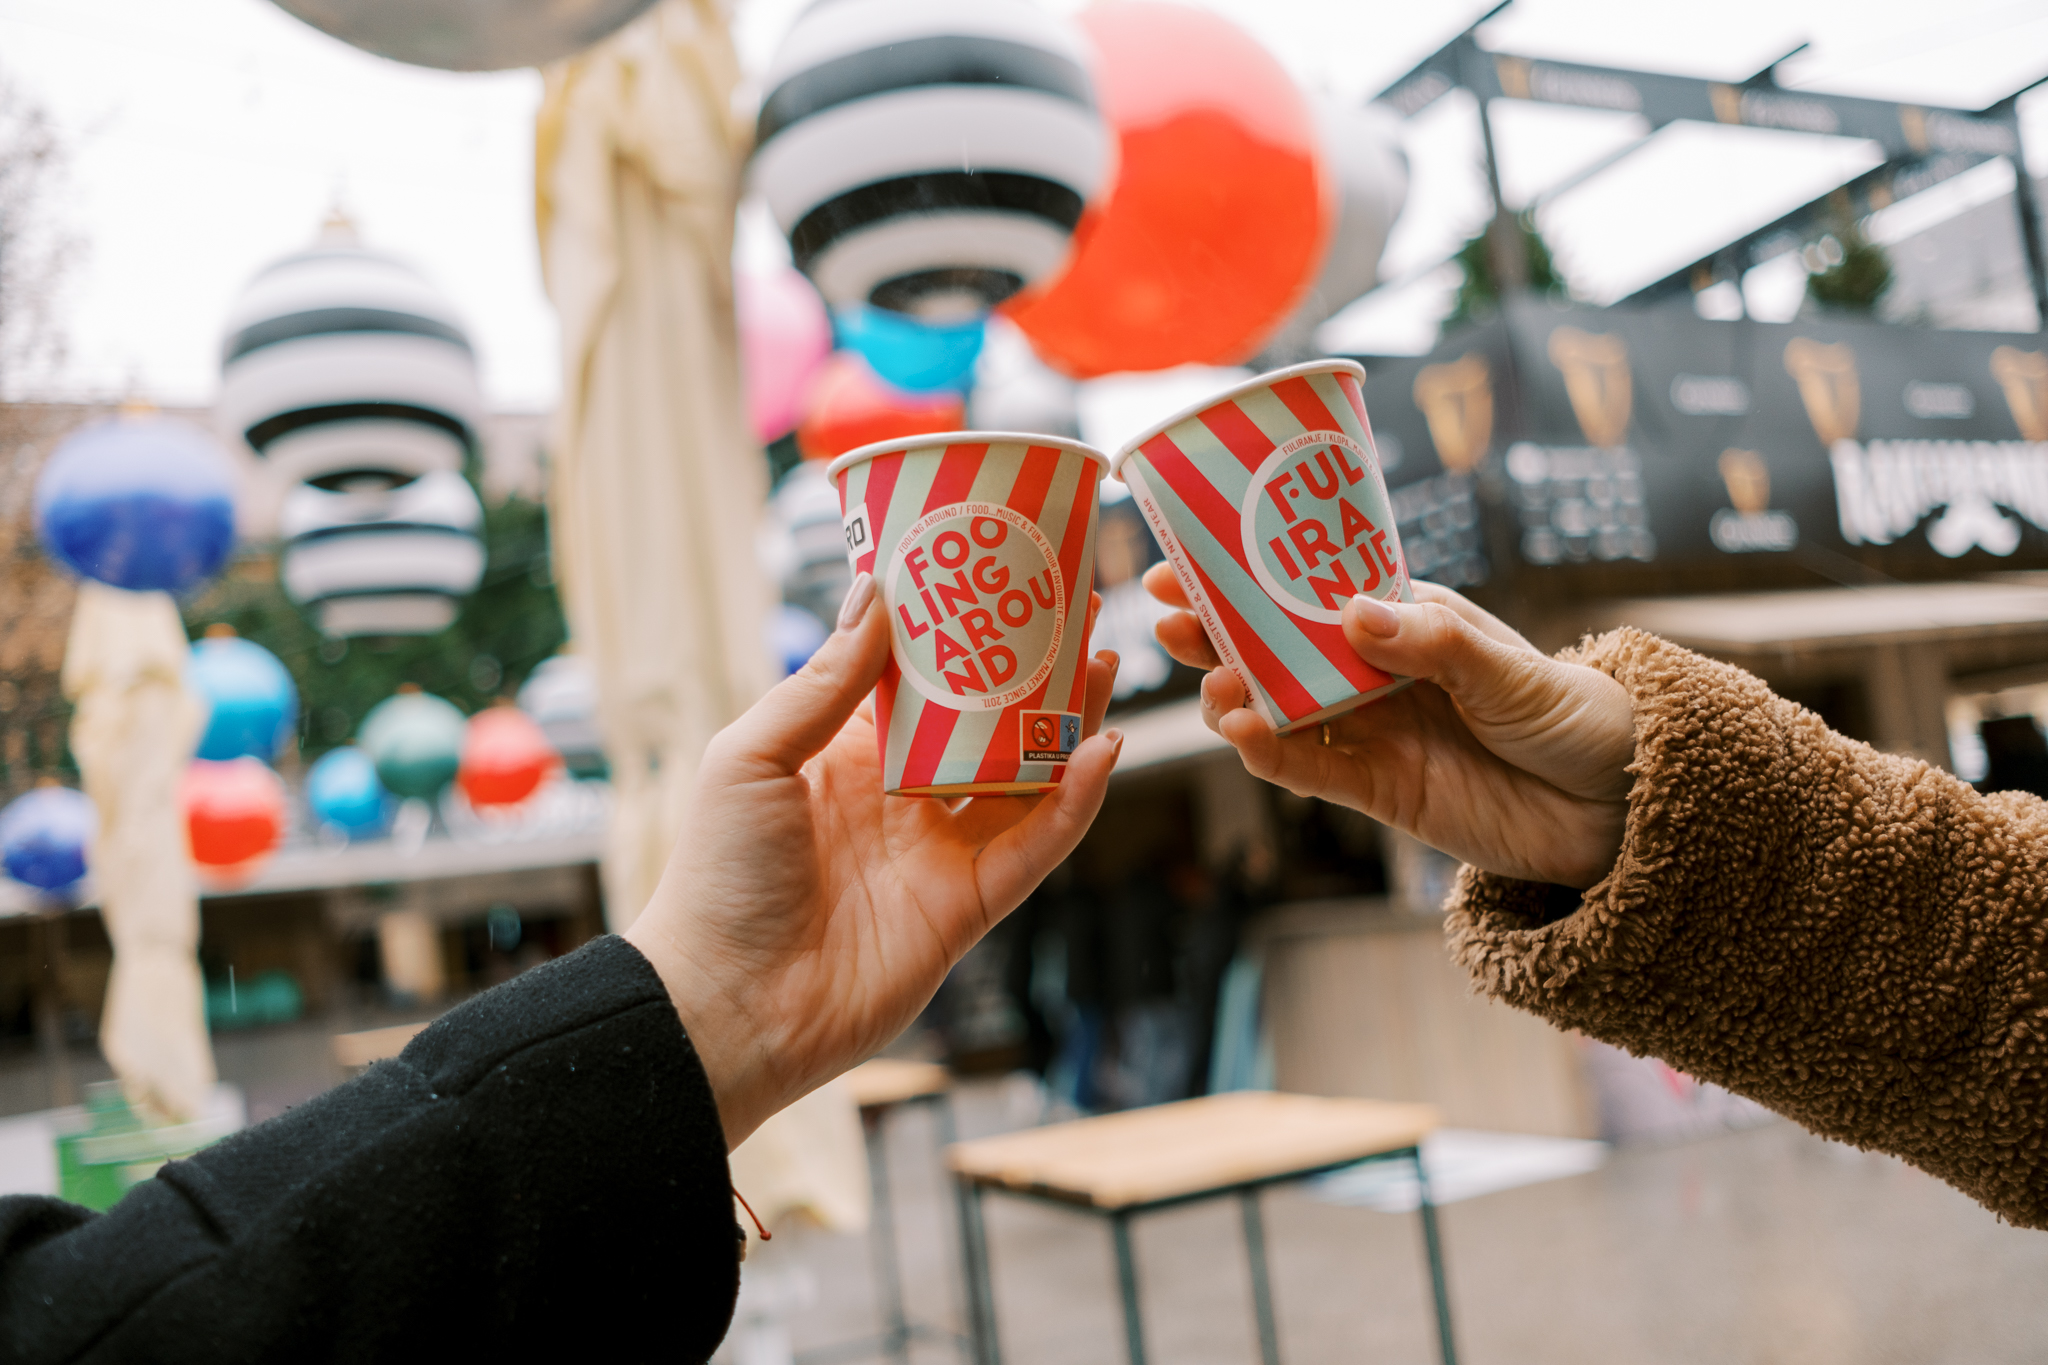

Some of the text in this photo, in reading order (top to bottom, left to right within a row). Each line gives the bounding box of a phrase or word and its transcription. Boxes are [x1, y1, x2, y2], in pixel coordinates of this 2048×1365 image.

[1282, 433, 1322, 456] FULIRANJE
[1264, 444, 1365, 525] FUL
[924, 507, 957, 528] AROUND
[1020, 520, 1028, 531] &
[1143, 498, 1161, 527] YEAR
[898, 524, 925, 554] FOOLING
[1027, 526, 1043, 543] FUN
[1159, 529, 1176, 554] NEW
[1268, 497, 1376, 581] IRA
[904, 516, 1008, 590] FOO
[1043, 546, 1057, 570] YOUR
[1173, 557, 1196, 591] HAPPY
[1307, 529, 1398, 610] NJE
[898, 556, 1010, 640] LING
[1053, 569, 1065, 617] FAVOURITE
[1193, 592, 1202, 603] &
[935, 568, 1056, 672] AROU
[1200, 604, 1235, 665] CHRISTMAS
[1046, 618, 1064, 664] CHRISTMAS
[943, 645, 1018, 696] ND
[1029, 662, 1050, 691] MARKET
[1003, 685, 1027, 705] SINCE
[1028, 752, 1056, 760] PLASTIKA
